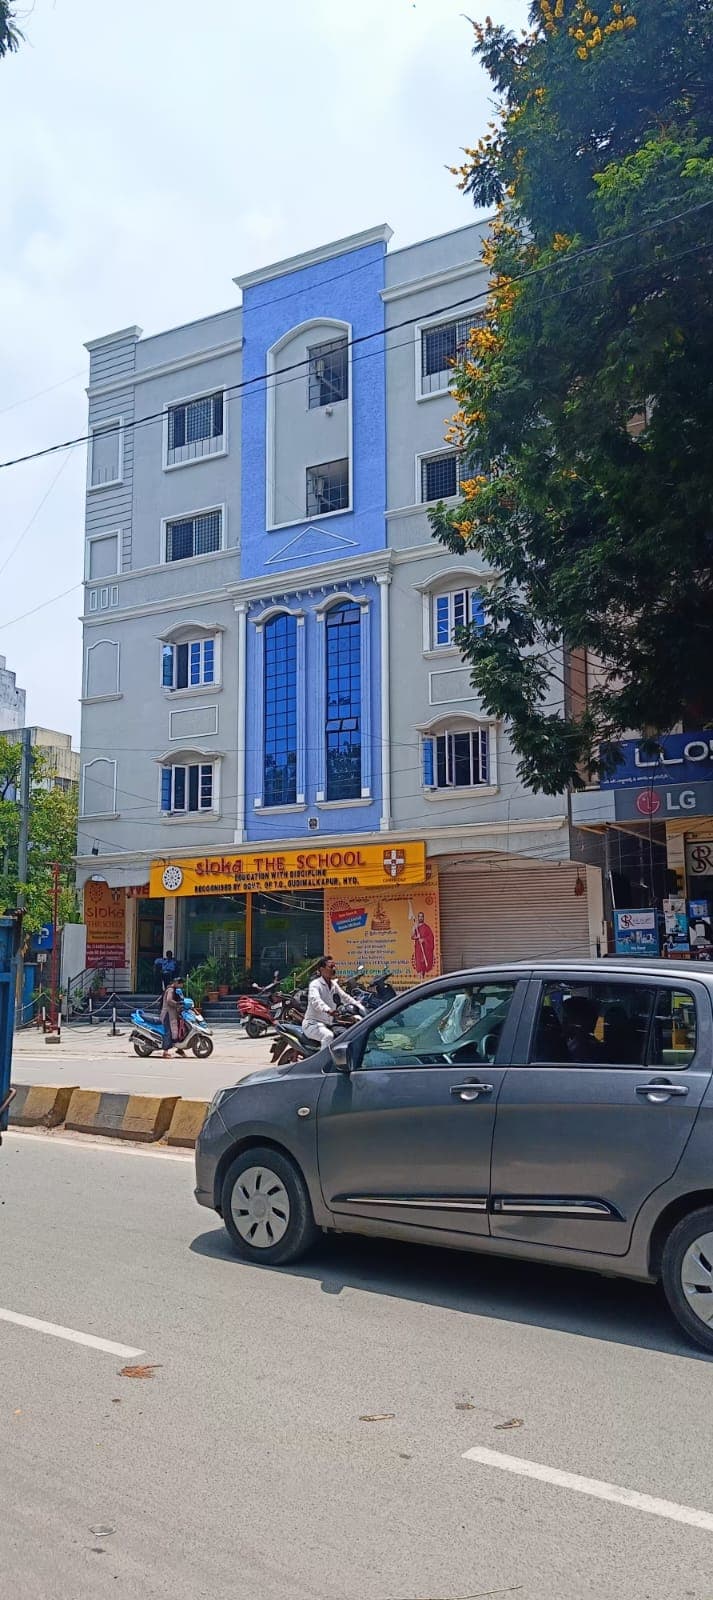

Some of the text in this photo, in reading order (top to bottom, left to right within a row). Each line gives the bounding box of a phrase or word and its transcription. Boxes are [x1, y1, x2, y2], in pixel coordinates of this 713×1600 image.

[634, 740, 713, 768] LLO
[666, 790, 696, 811] LG
[253, 856, 285, 872] THE
[296, 851, 366, 870] SCHOOL
[194, 883, 233, 893] RECOGNISED
[233, 882, 241, 891] BY
[243, 881, 262, 890] GOVT.
[264, 880, 273, 889] OF
[343, 876, 359, 885] HYD.
[234, 868, 327, 882] EDUCATION WITH DISCIPLINE
[38, 927, 50, 945] P
